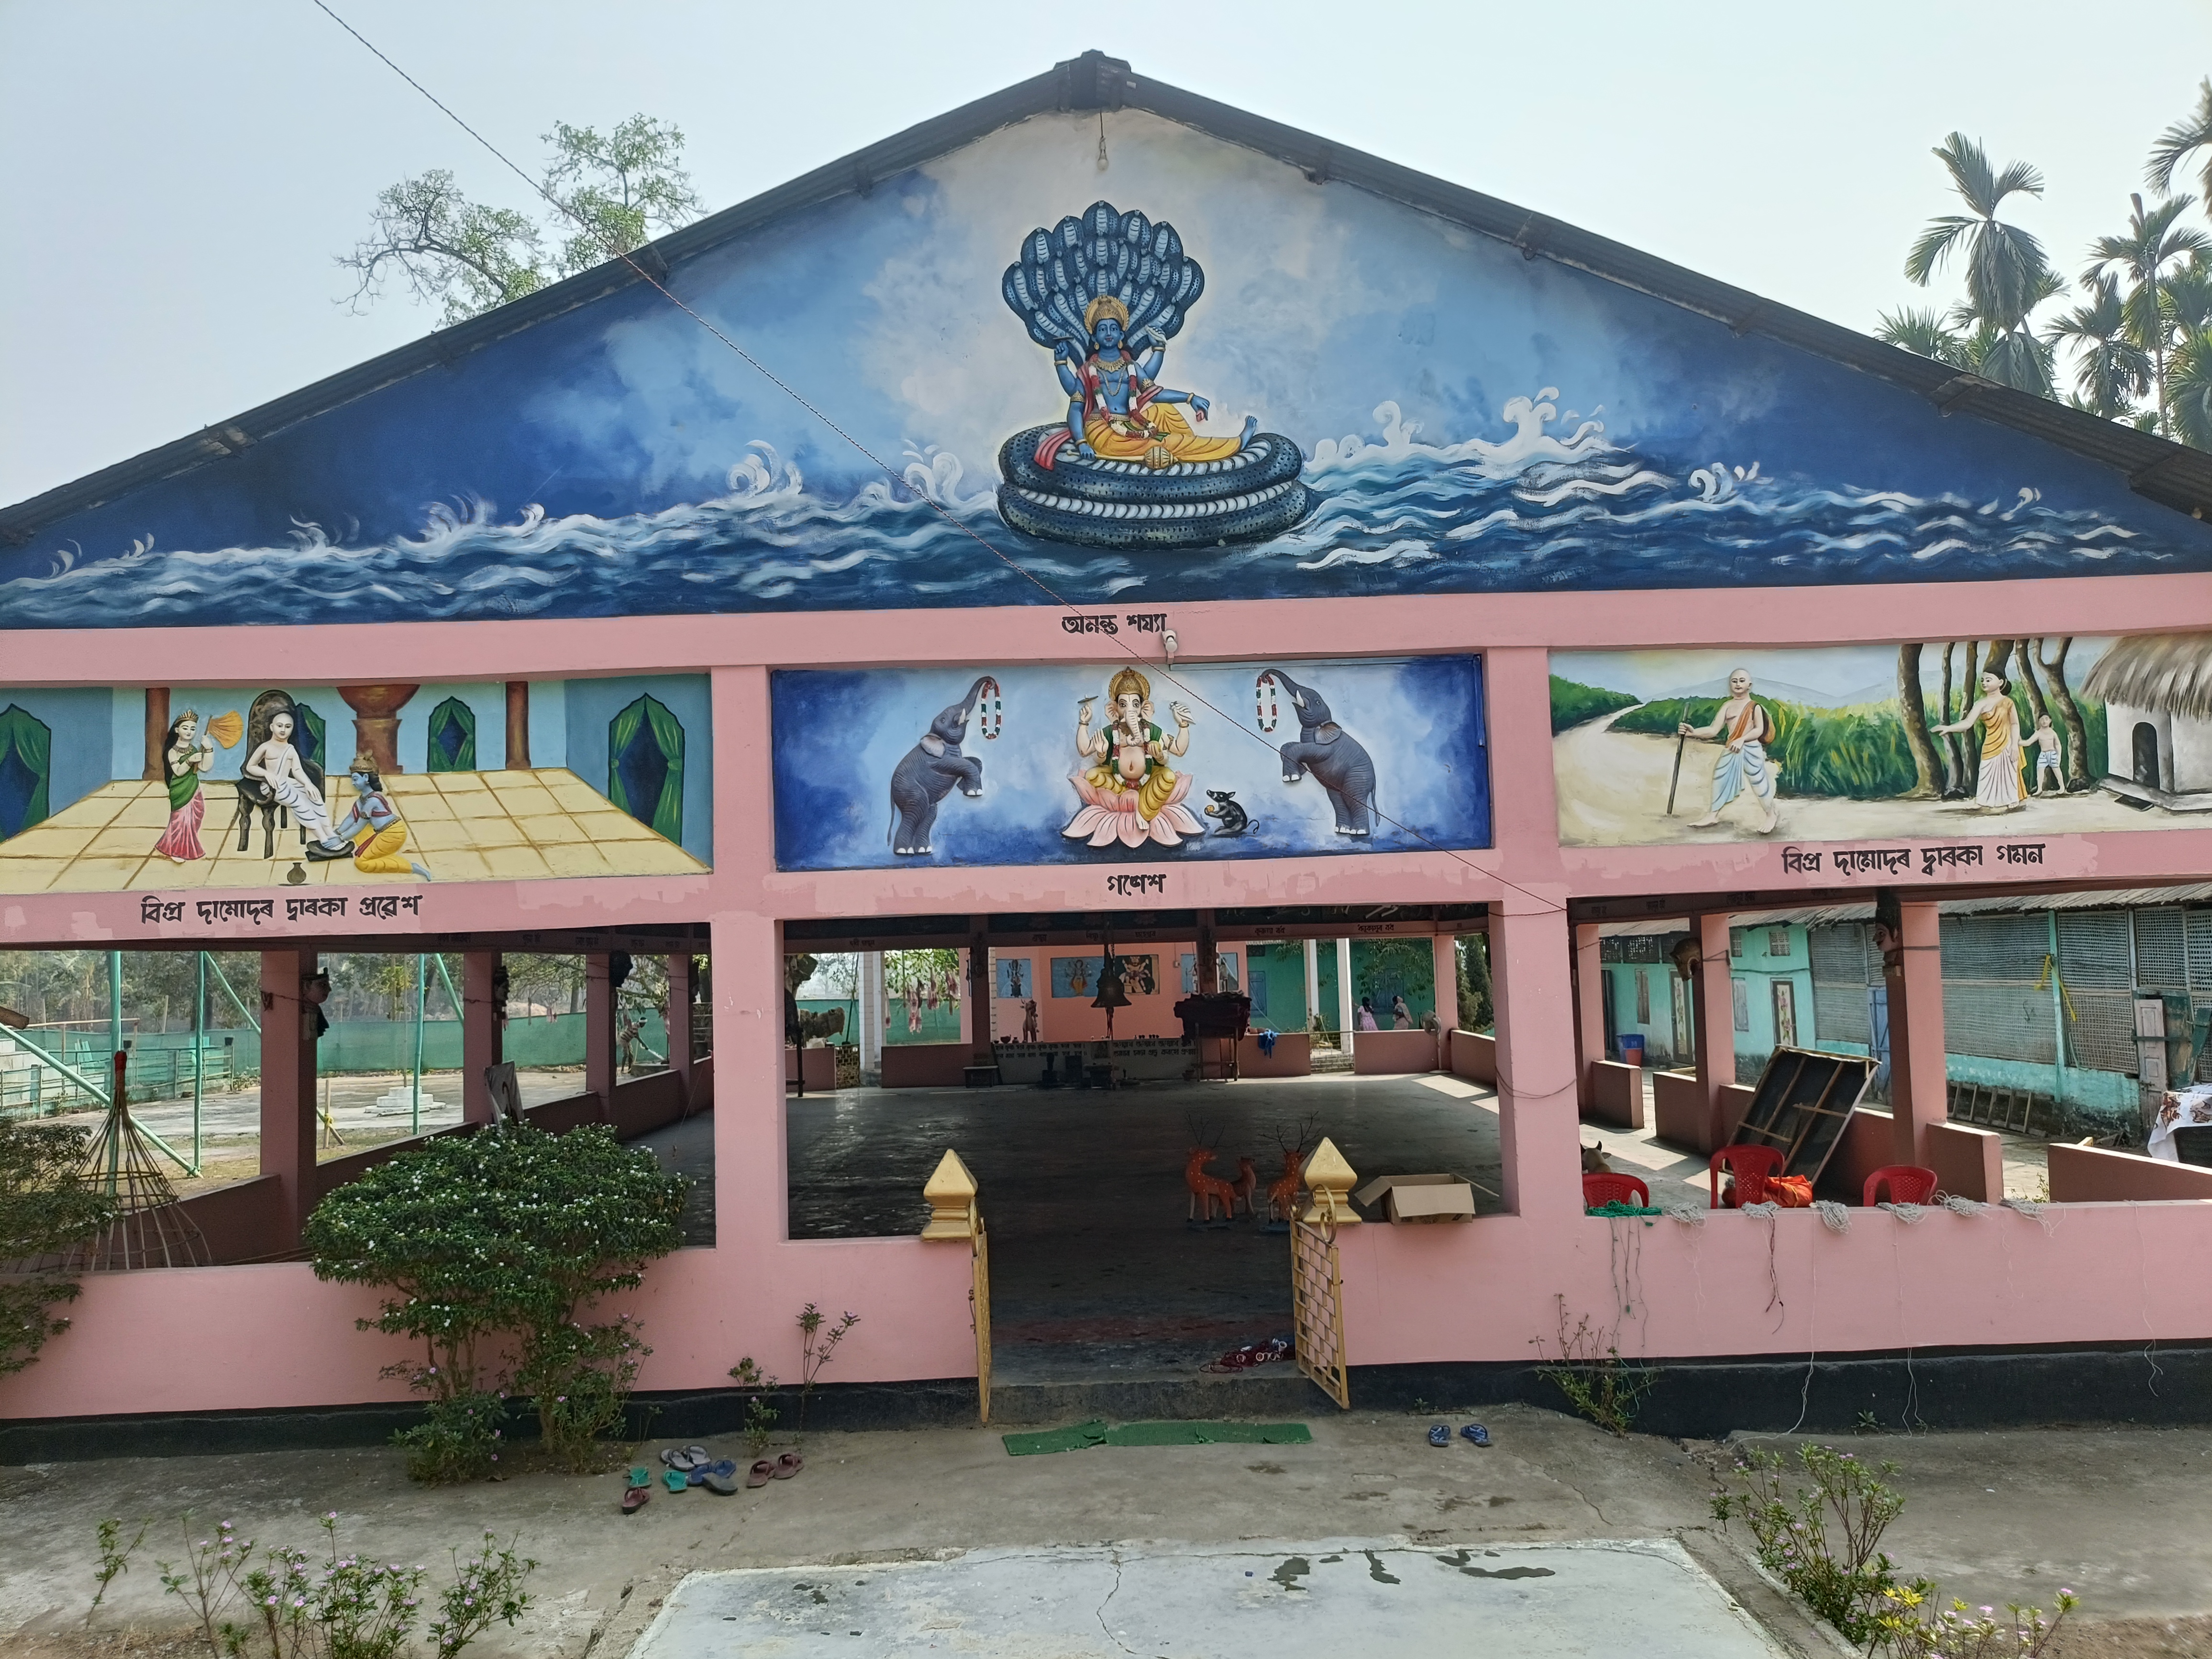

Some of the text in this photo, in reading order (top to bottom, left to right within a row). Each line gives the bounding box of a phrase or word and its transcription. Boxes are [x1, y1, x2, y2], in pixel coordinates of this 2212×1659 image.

[1062, 613, 1167, 634] অনন্ত শয্যা
[1781, 843, 2046, 876] বিপ্ৰ দামোদৰ দ্বাৰকা গমন
[1106, 874, 1167, 896] গণেশ
[140, 895, 186, 924] বিপ্ৰ
[196, 899, 274, 925] দামোদৰ
[286, 897, 348, 922] দ্বাৰকা
